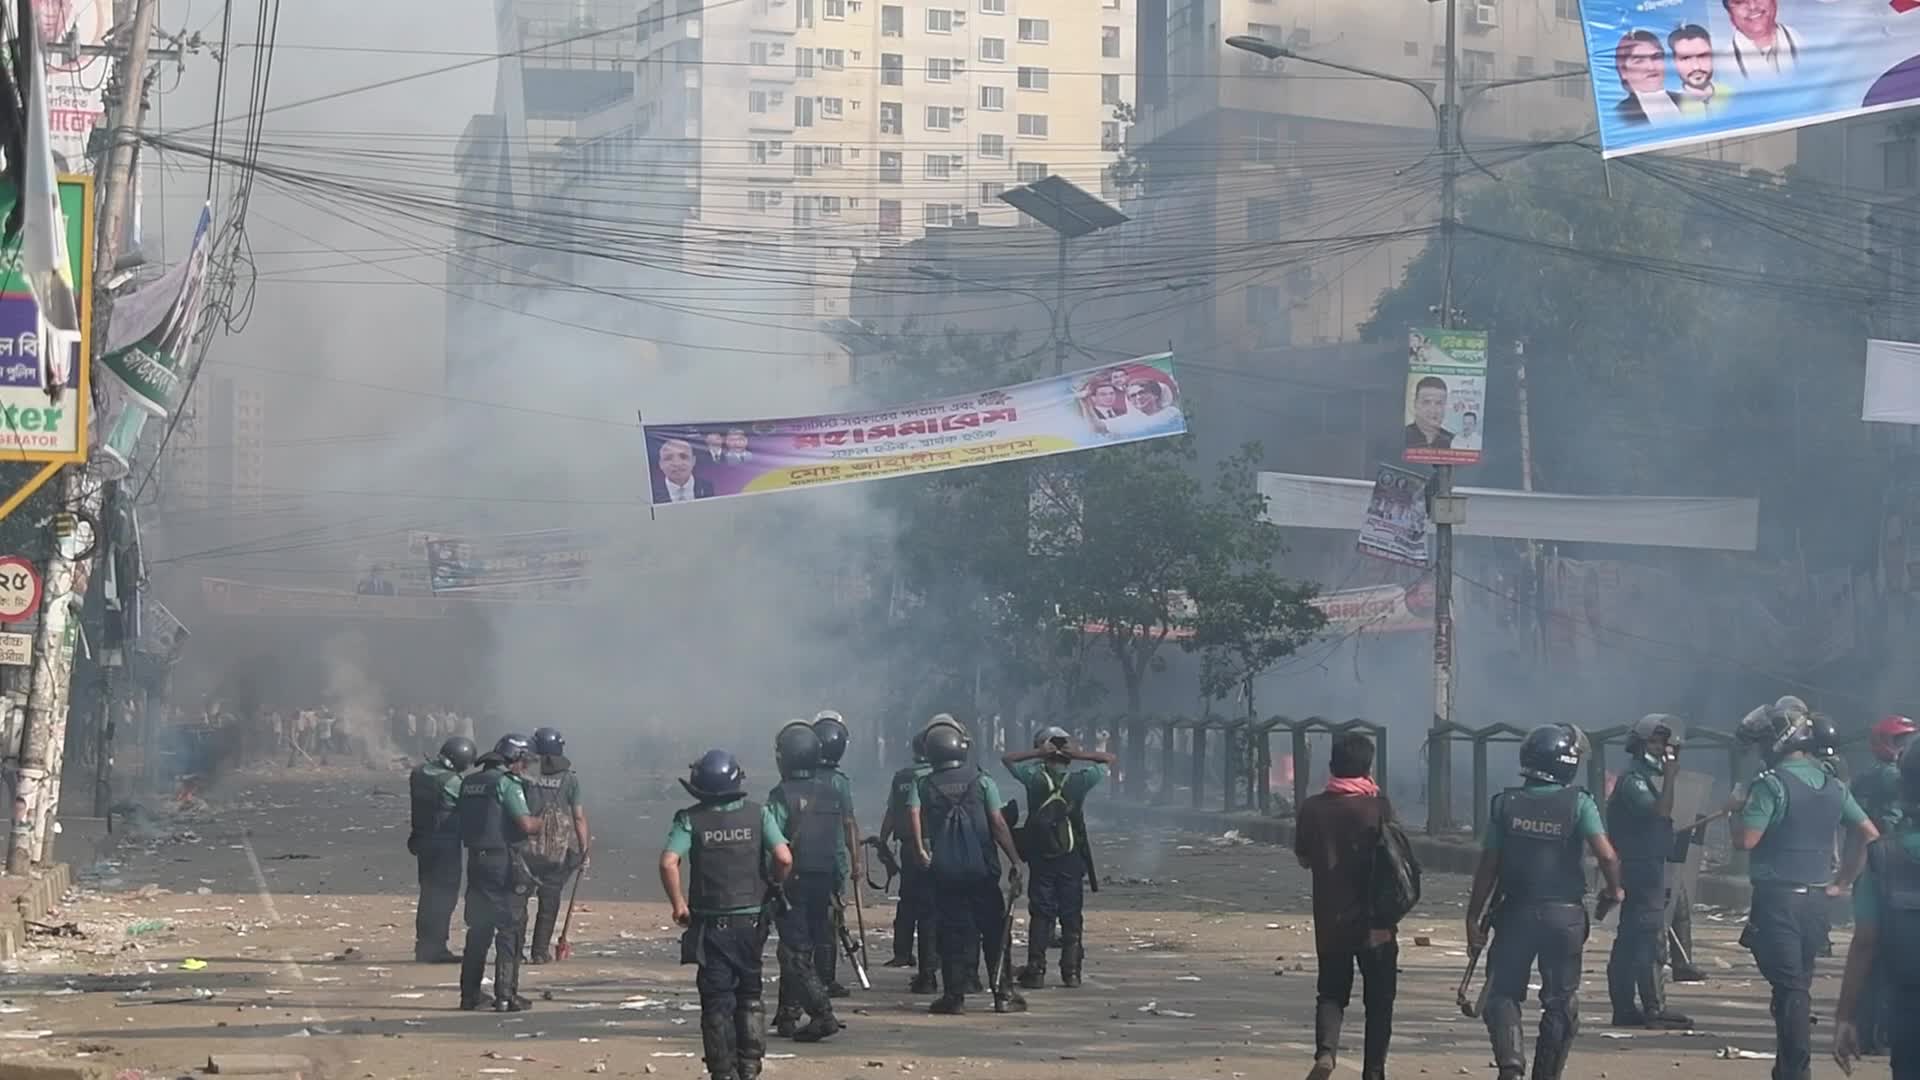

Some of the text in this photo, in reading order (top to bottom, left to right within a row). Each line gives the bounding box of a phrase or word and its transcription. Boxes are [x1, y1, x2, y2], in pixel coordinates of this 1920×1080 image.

[791, 407, 1017, 449] মহাসমাবেশ
[789, 464, 841, 479] মোঃ
[961, 440, 1034, 456] আলম
[704, 828, 752, 842] POLICE
[1512, 818, 1562, 835] POLICE
